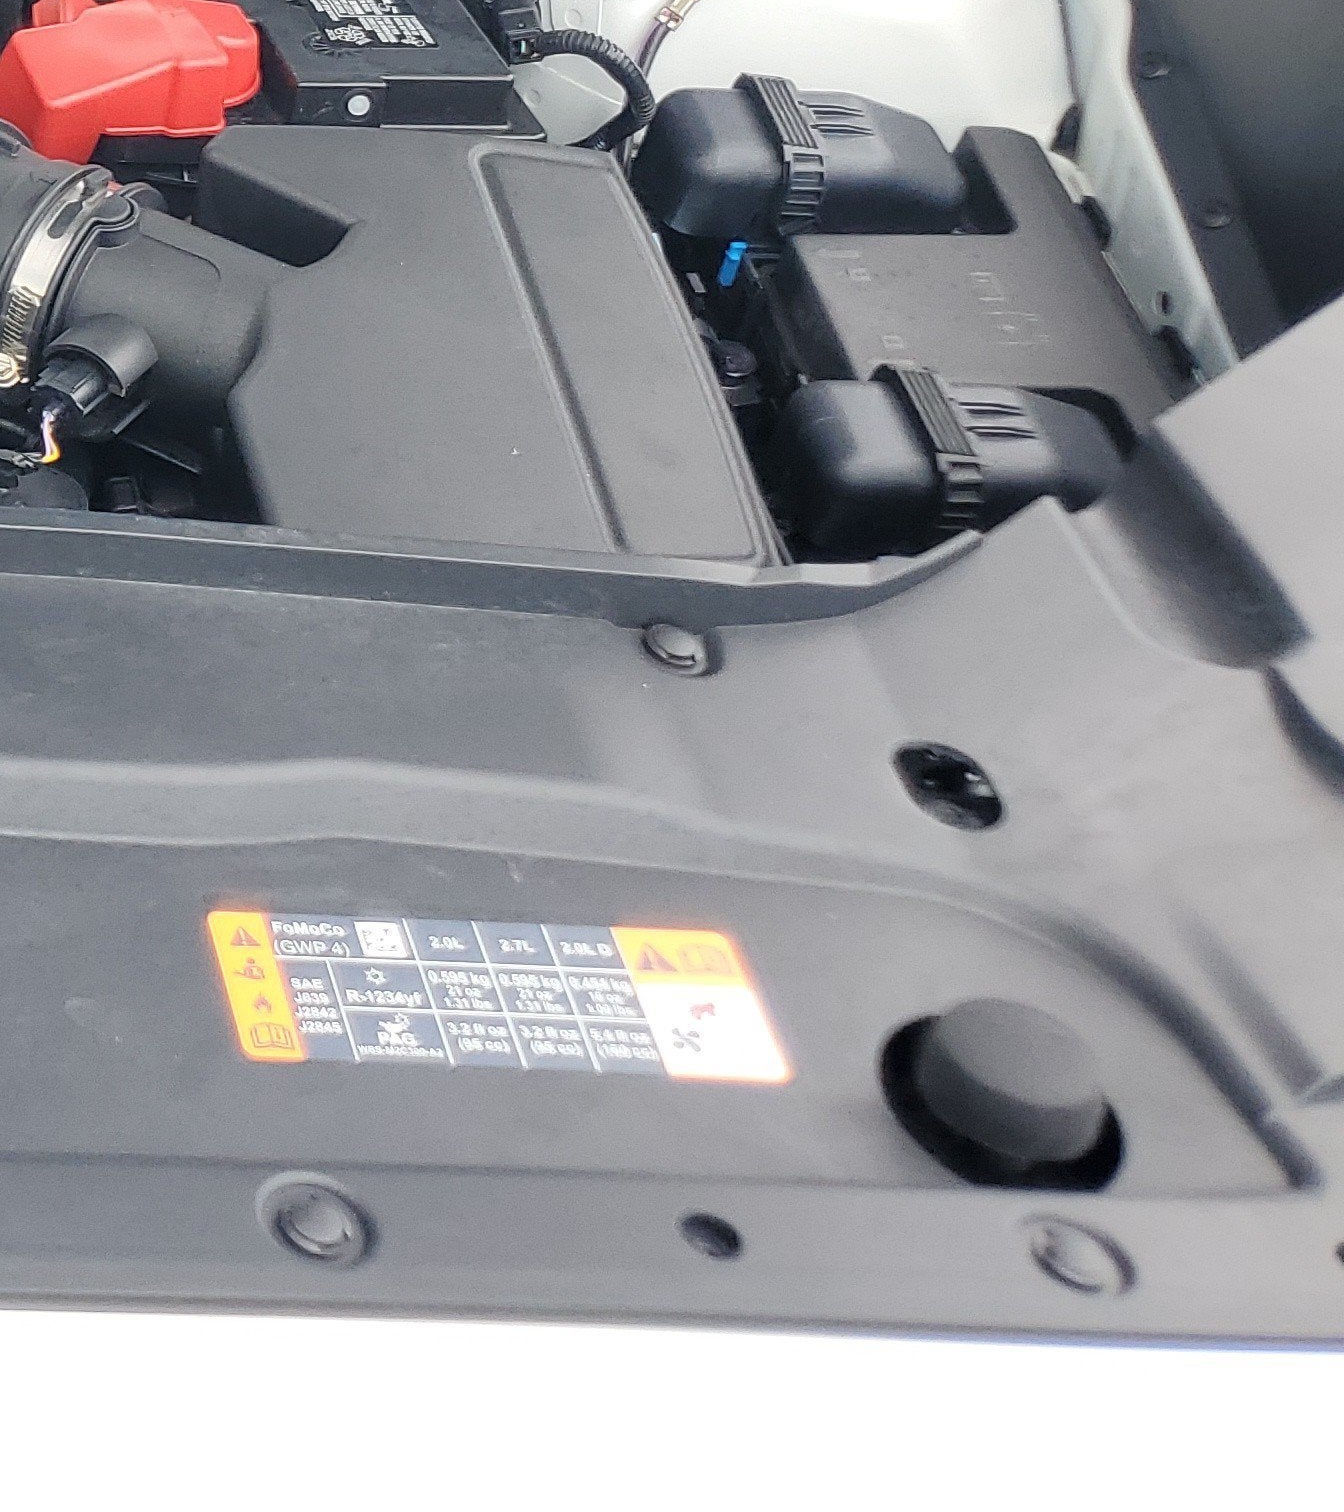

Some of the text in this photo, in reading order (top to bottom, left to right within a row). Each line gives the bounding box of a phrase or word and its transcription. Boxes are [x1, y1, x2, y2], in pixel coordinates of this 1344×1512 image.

[270, 920, 347, 937] FoMoCo
[274, 938, 351, 958] (GWP 4)
[427, 934, 466, 950] 2.0L
[497, 938, 537, 953] 2.7L
[290, 977, 324, 989] SAE
[470, 972, 489, 988] kg
[541, 975, 563, 992] kg
[344, 988, 423, 1007] R-1234yf
[465, 986, 483, 997] oz
[377, 1031, 418, 1046] PAG
[487, 1025, 510, 1037] oz
[559, 1028, 582, 1040] oz
